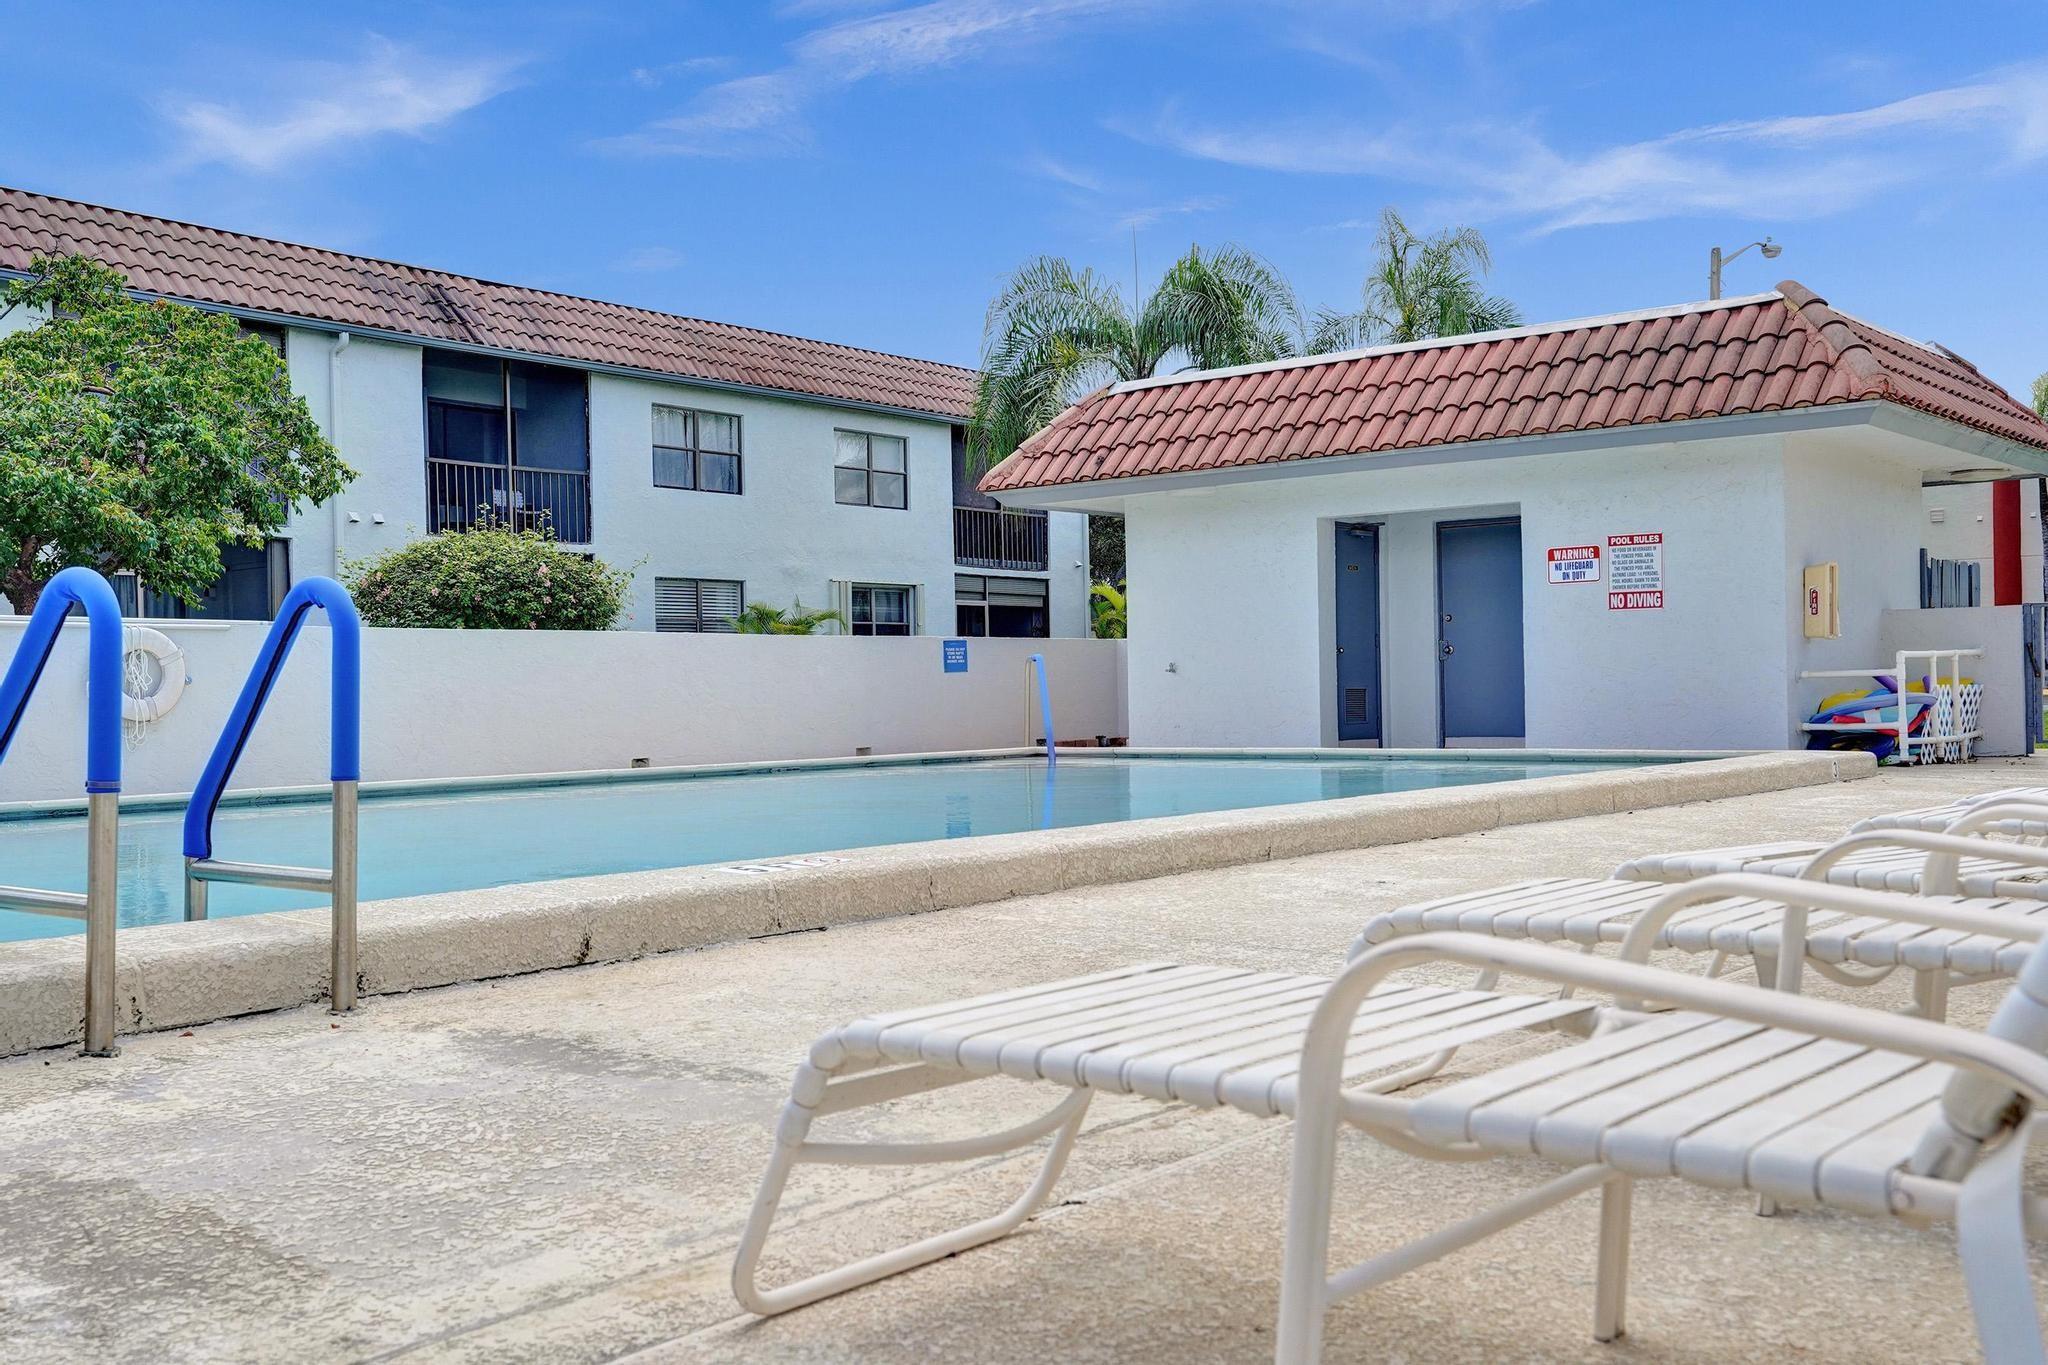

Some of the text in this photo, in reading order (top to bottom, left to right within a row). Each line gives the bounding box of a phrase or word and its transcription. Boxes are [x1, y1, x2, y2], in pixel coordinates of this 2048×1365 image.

[1610, 534, 1660, 545] POOL RULES
[1554, 548, 1594, 560] WARNING
[1555, 561, 1593, 571] NO LIFEGUARD
[1562, 571, 1586, 580] ON DUTY
[1610, 592, 1661, 608] NO DIVING
